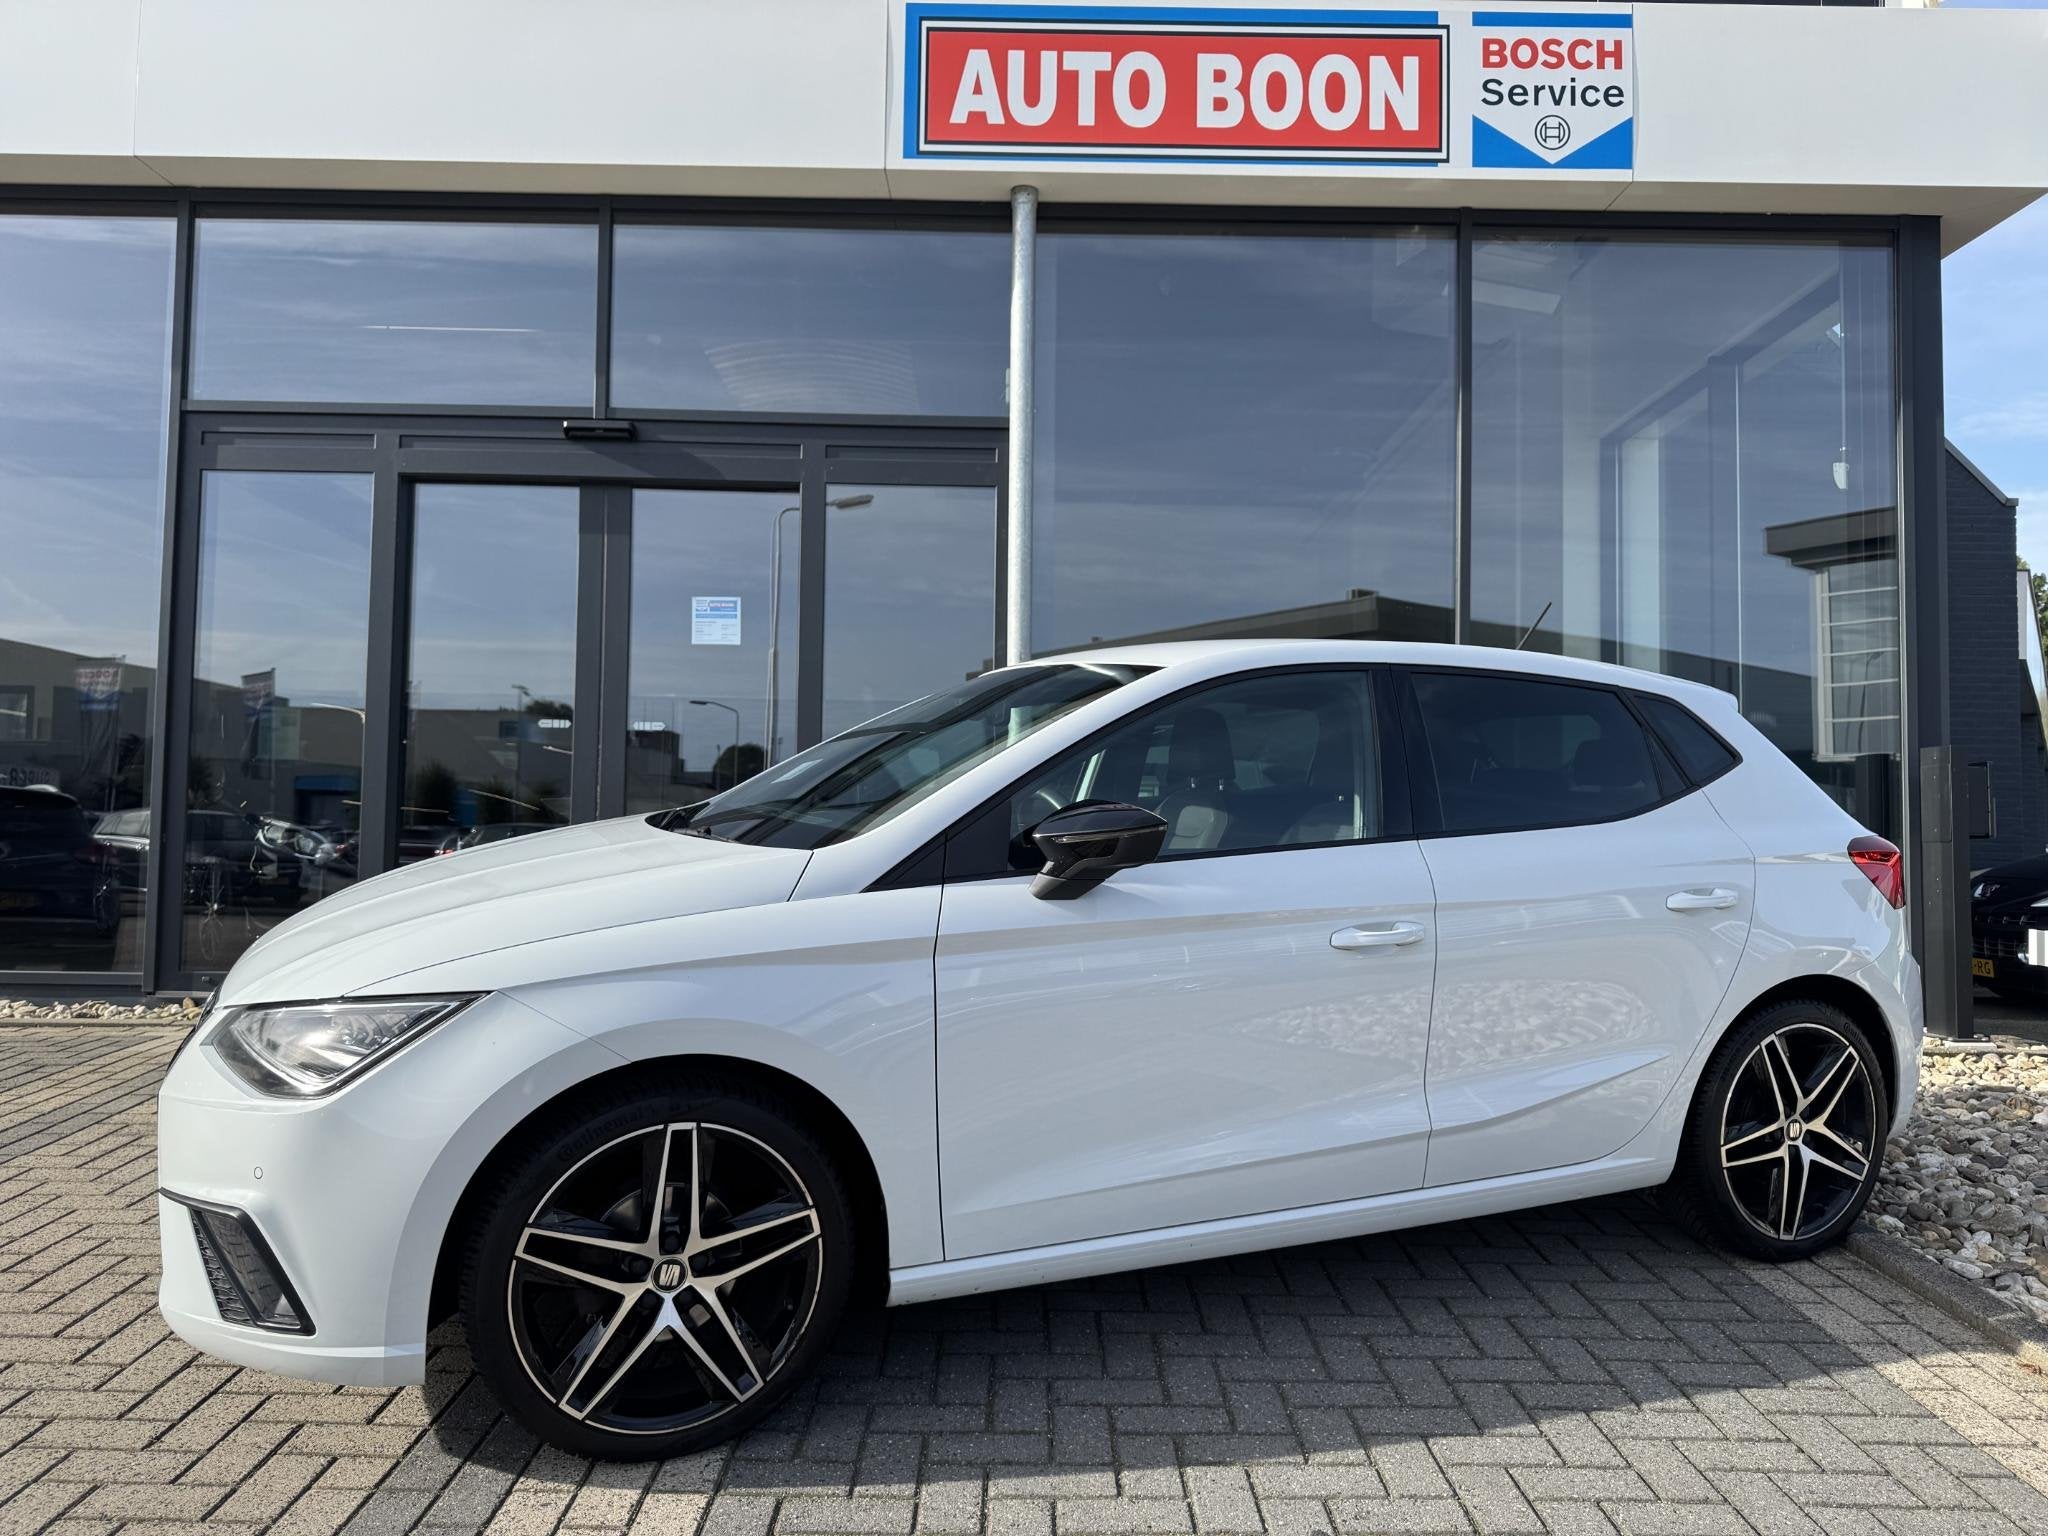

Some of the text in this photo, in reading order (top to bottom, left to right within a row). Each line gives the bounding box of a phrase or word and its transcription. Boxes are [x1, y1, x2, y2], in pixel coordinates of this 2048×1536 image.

[1481, 37, 1624, 70] BOSCH
[949, 48, 1420, 133] AUTO BOON
[1480, 78, 1625, 109] Service
